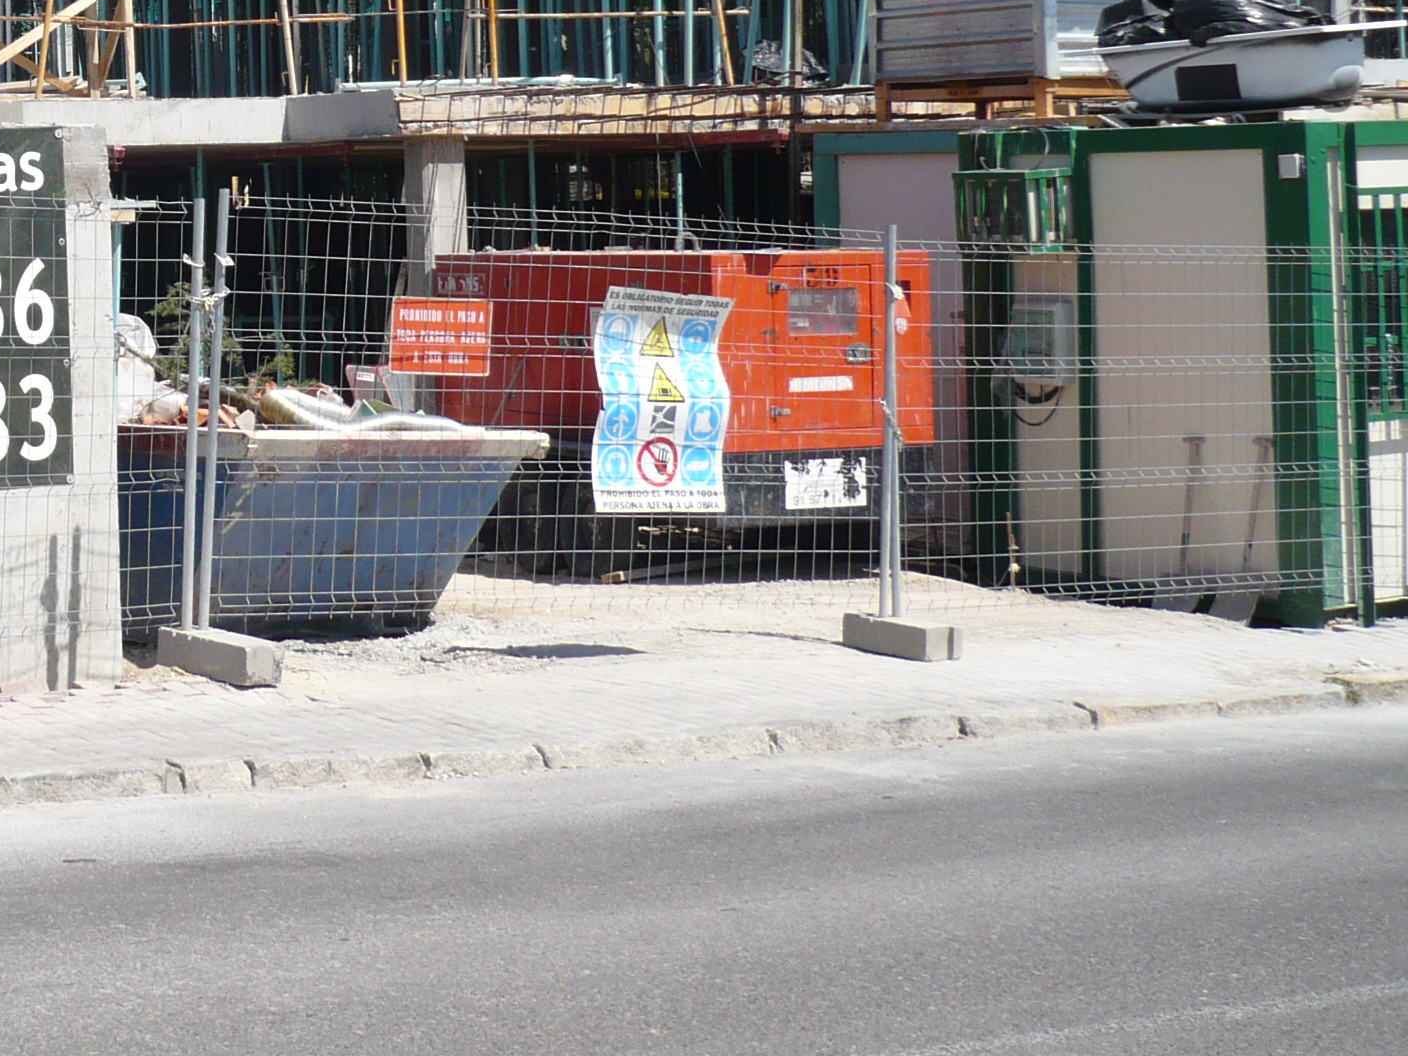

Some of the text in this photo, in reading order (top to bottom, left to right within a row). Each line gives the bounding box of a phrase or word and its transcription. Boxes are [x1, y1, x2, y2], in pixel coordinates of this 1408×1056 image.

[609, 290, 621, 299] ES
[621, 292, 673, 304] OBLIGATORIO
[399, 308, 484, 323] PROHIBIDO EL PASO A
[663, 306, 675, 314] DE
[676, 307, 720, 318] SEGURIDAD
[599, 489, 719, 498] PROHIBIDO EL PASO A TODA
[603, 501, 720, 510] PERSONA AJENA A LA OBRA
